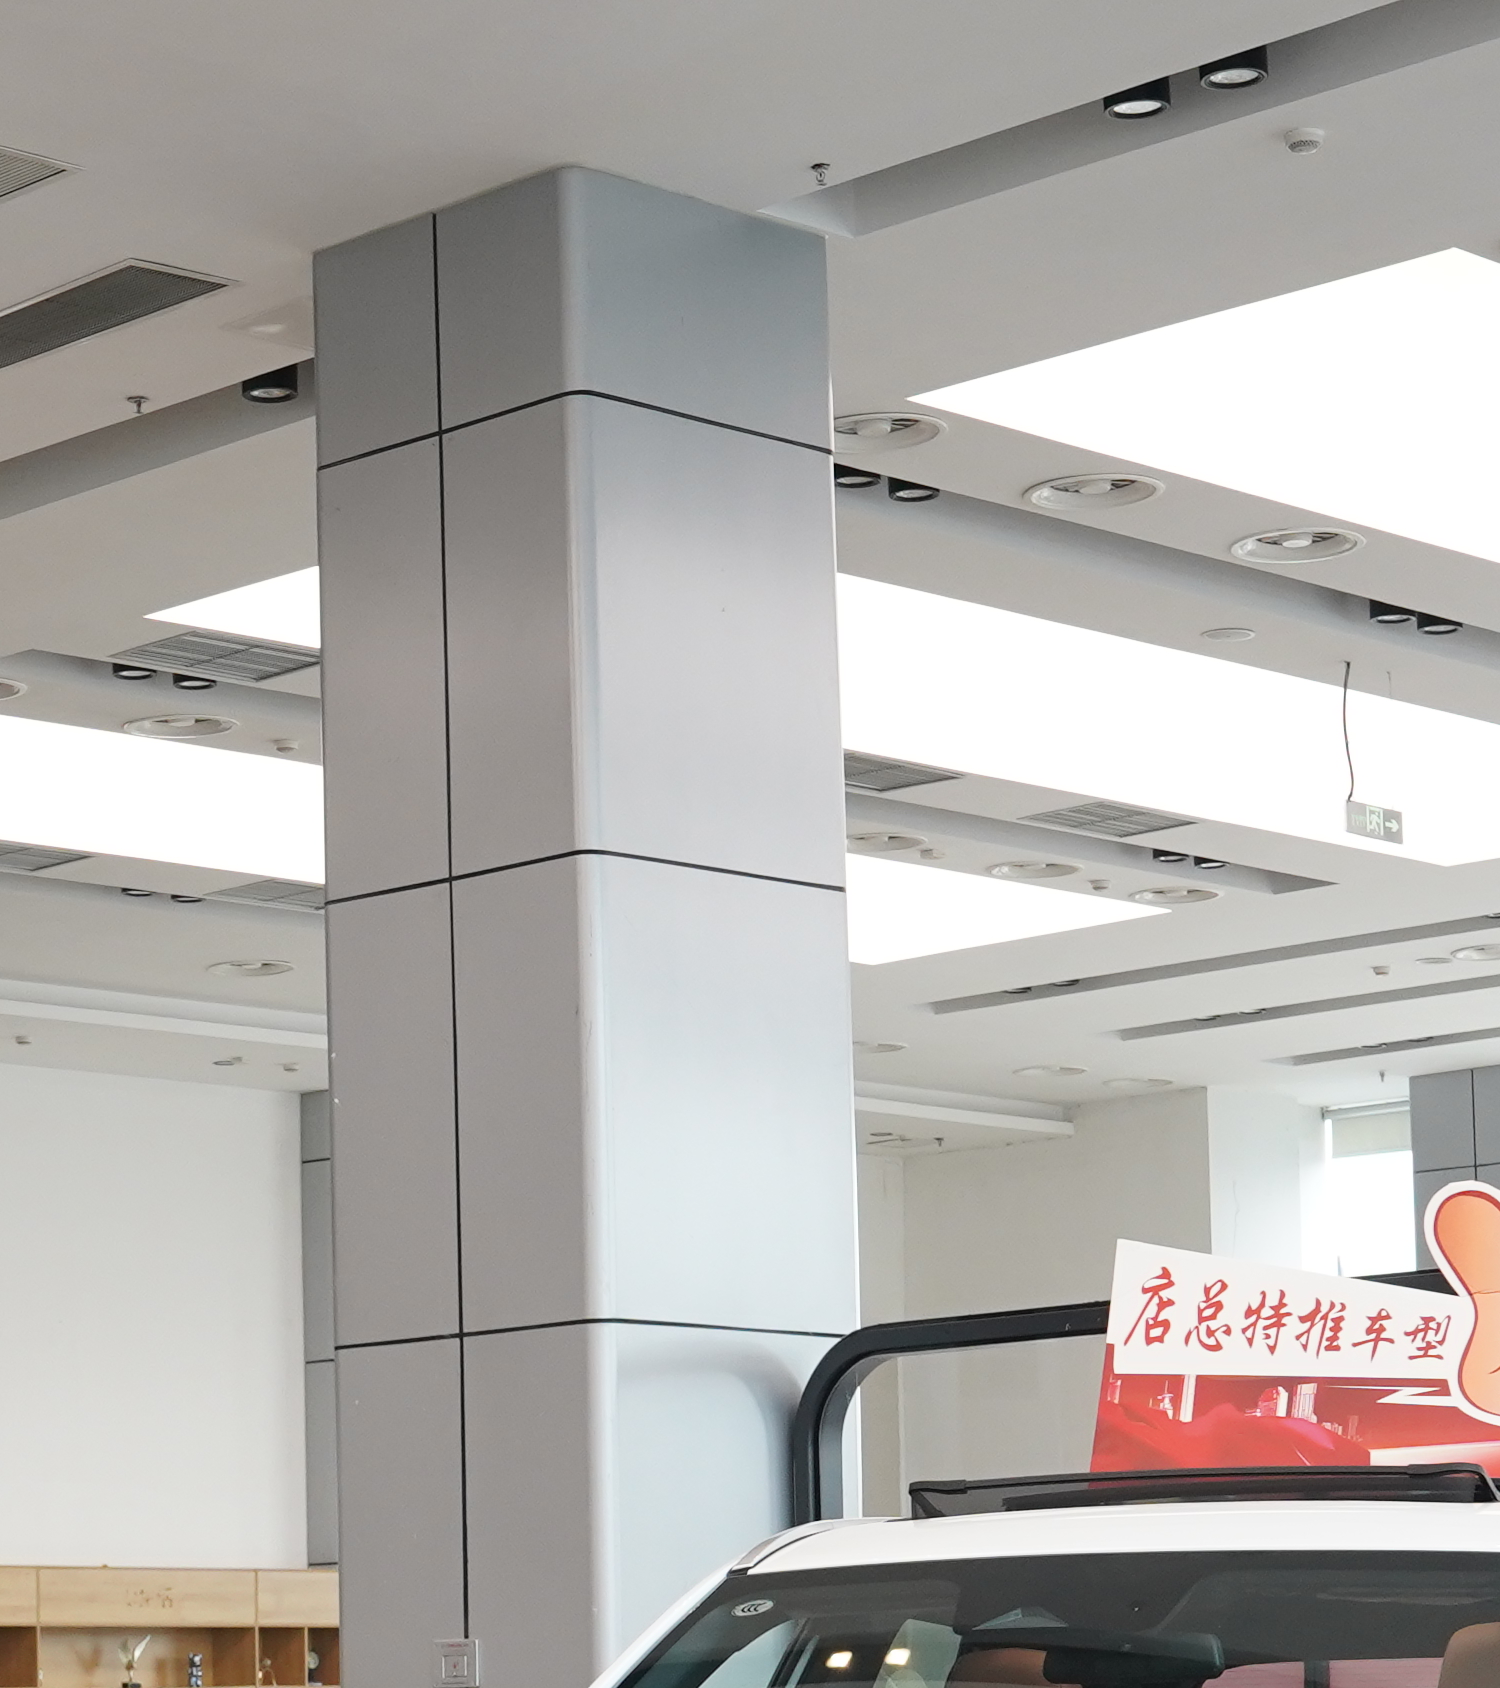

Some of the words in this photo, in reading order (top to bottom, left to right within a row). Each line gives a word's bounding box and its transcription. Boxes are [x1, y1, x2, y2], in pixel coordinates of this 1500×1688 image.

[1123, 1266, 1452, 1362] 店总特推车型
